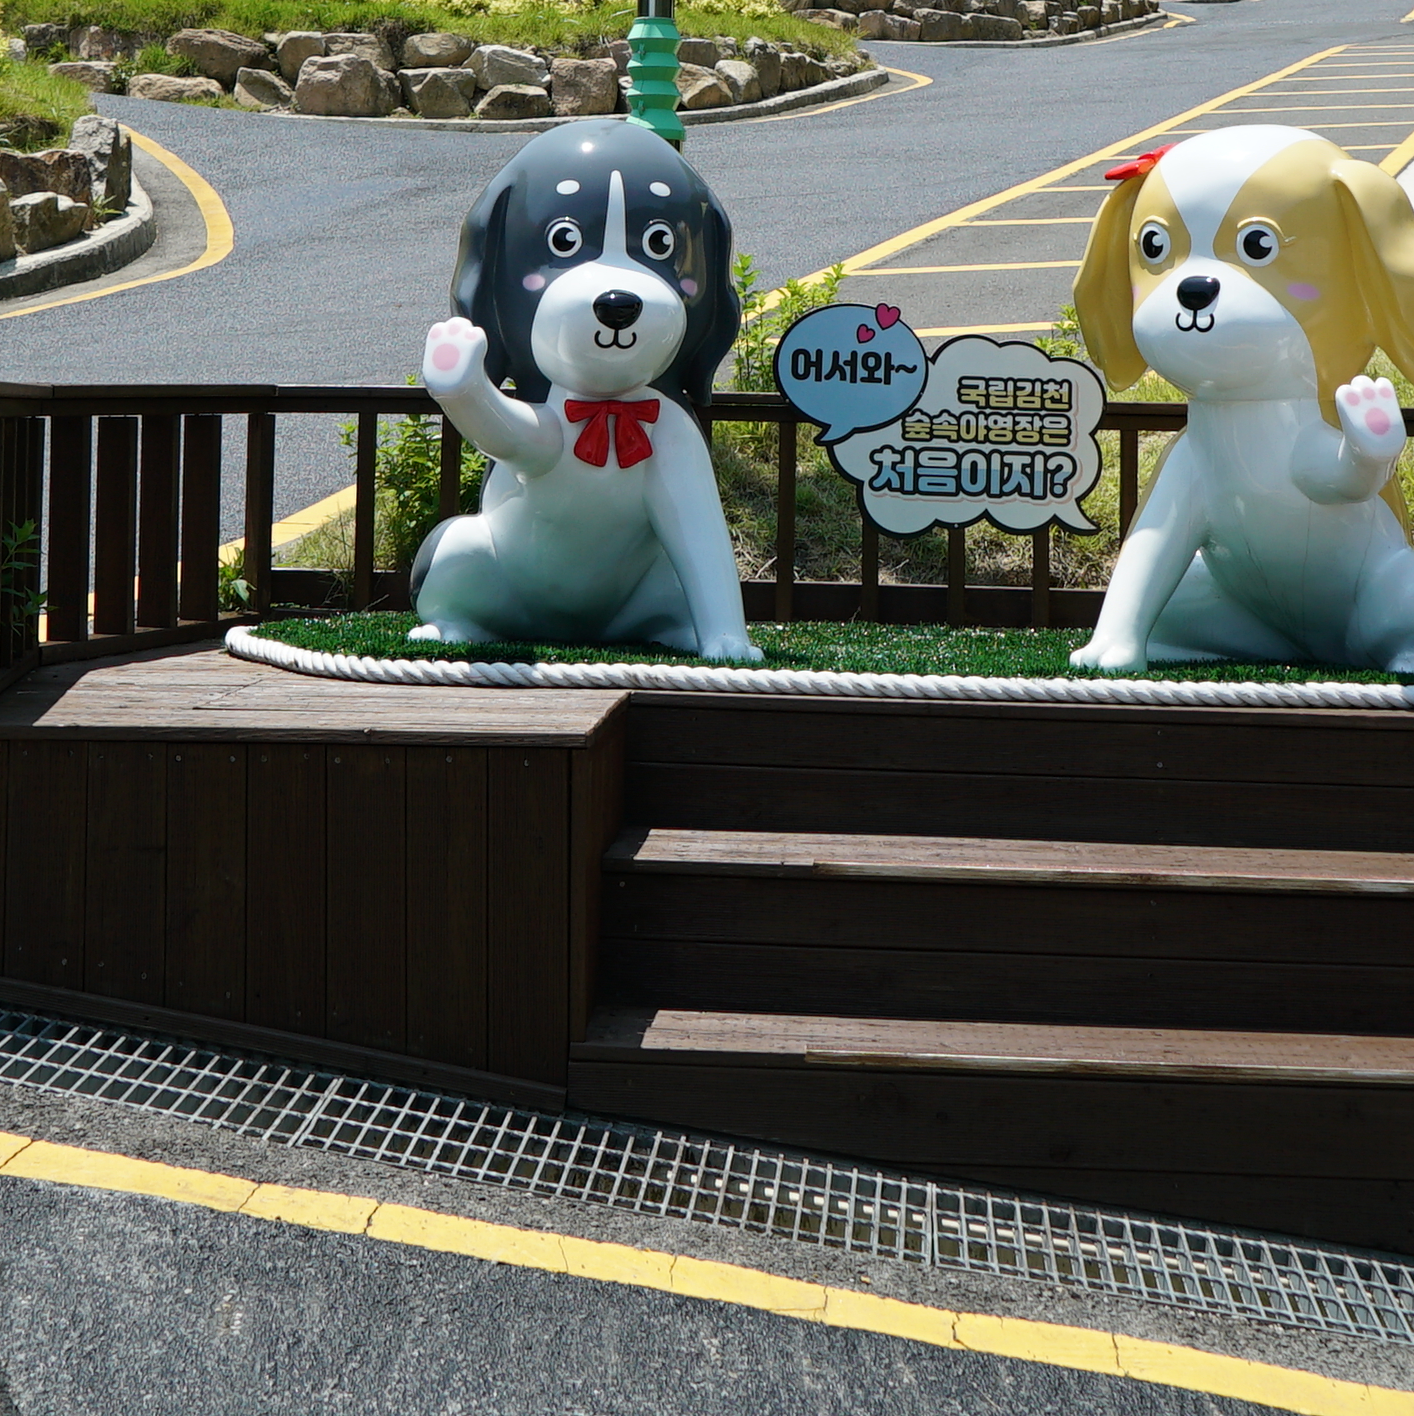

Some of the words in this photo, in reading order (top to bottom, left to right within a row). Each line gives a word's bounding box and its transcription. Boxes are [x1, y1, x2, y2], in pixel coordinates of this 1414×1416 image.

[791, 348, 918, 385] 어서와~
[957, 377, 1073, 411] 국립김천
[902, 410, 1071, 445] 숲속야영장은
[869, 446, 1077, 499] 처음이지?
